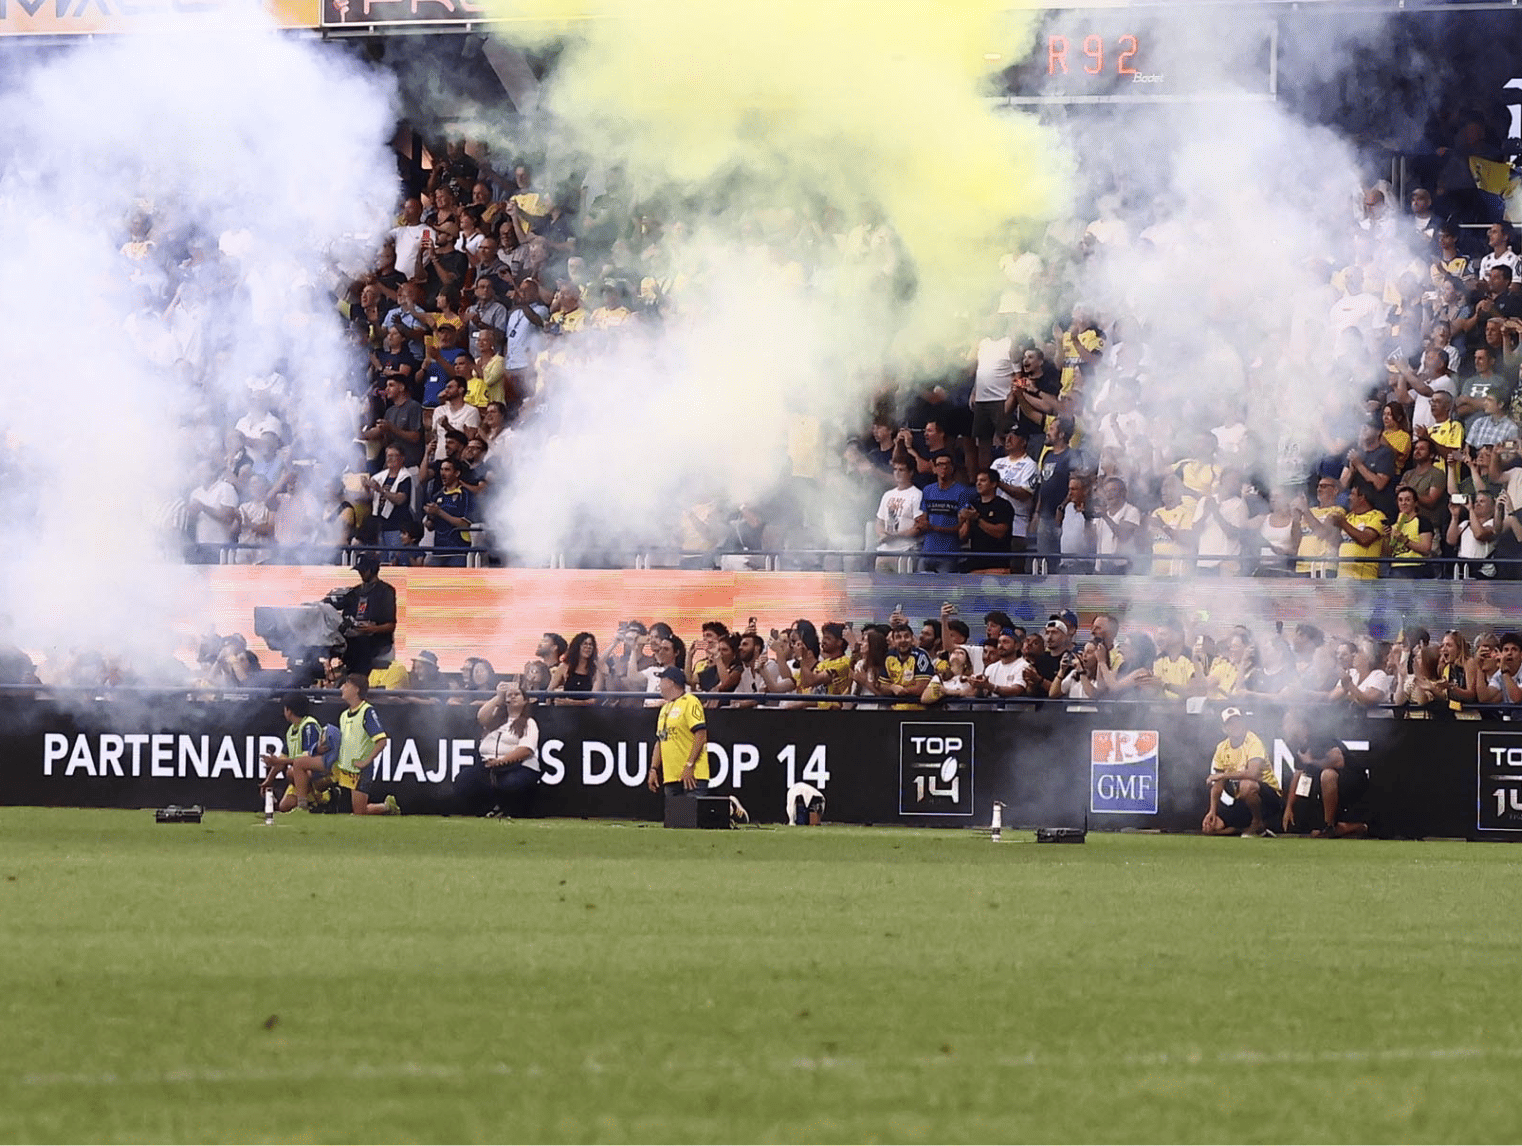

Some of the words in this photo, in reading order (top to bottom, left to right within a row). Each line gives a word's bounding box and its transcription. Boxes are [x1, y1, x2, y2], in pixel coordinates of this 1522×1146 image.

[910, 737, 963, 755] TOP
[44, 733, 285, 779] PARTENAIR
[582, 741, 648, 787] DU
[777, 744, 830, 790] 14
[913, 775, 959, 803] 14
[1097, 774, 1153, 800] GMF
